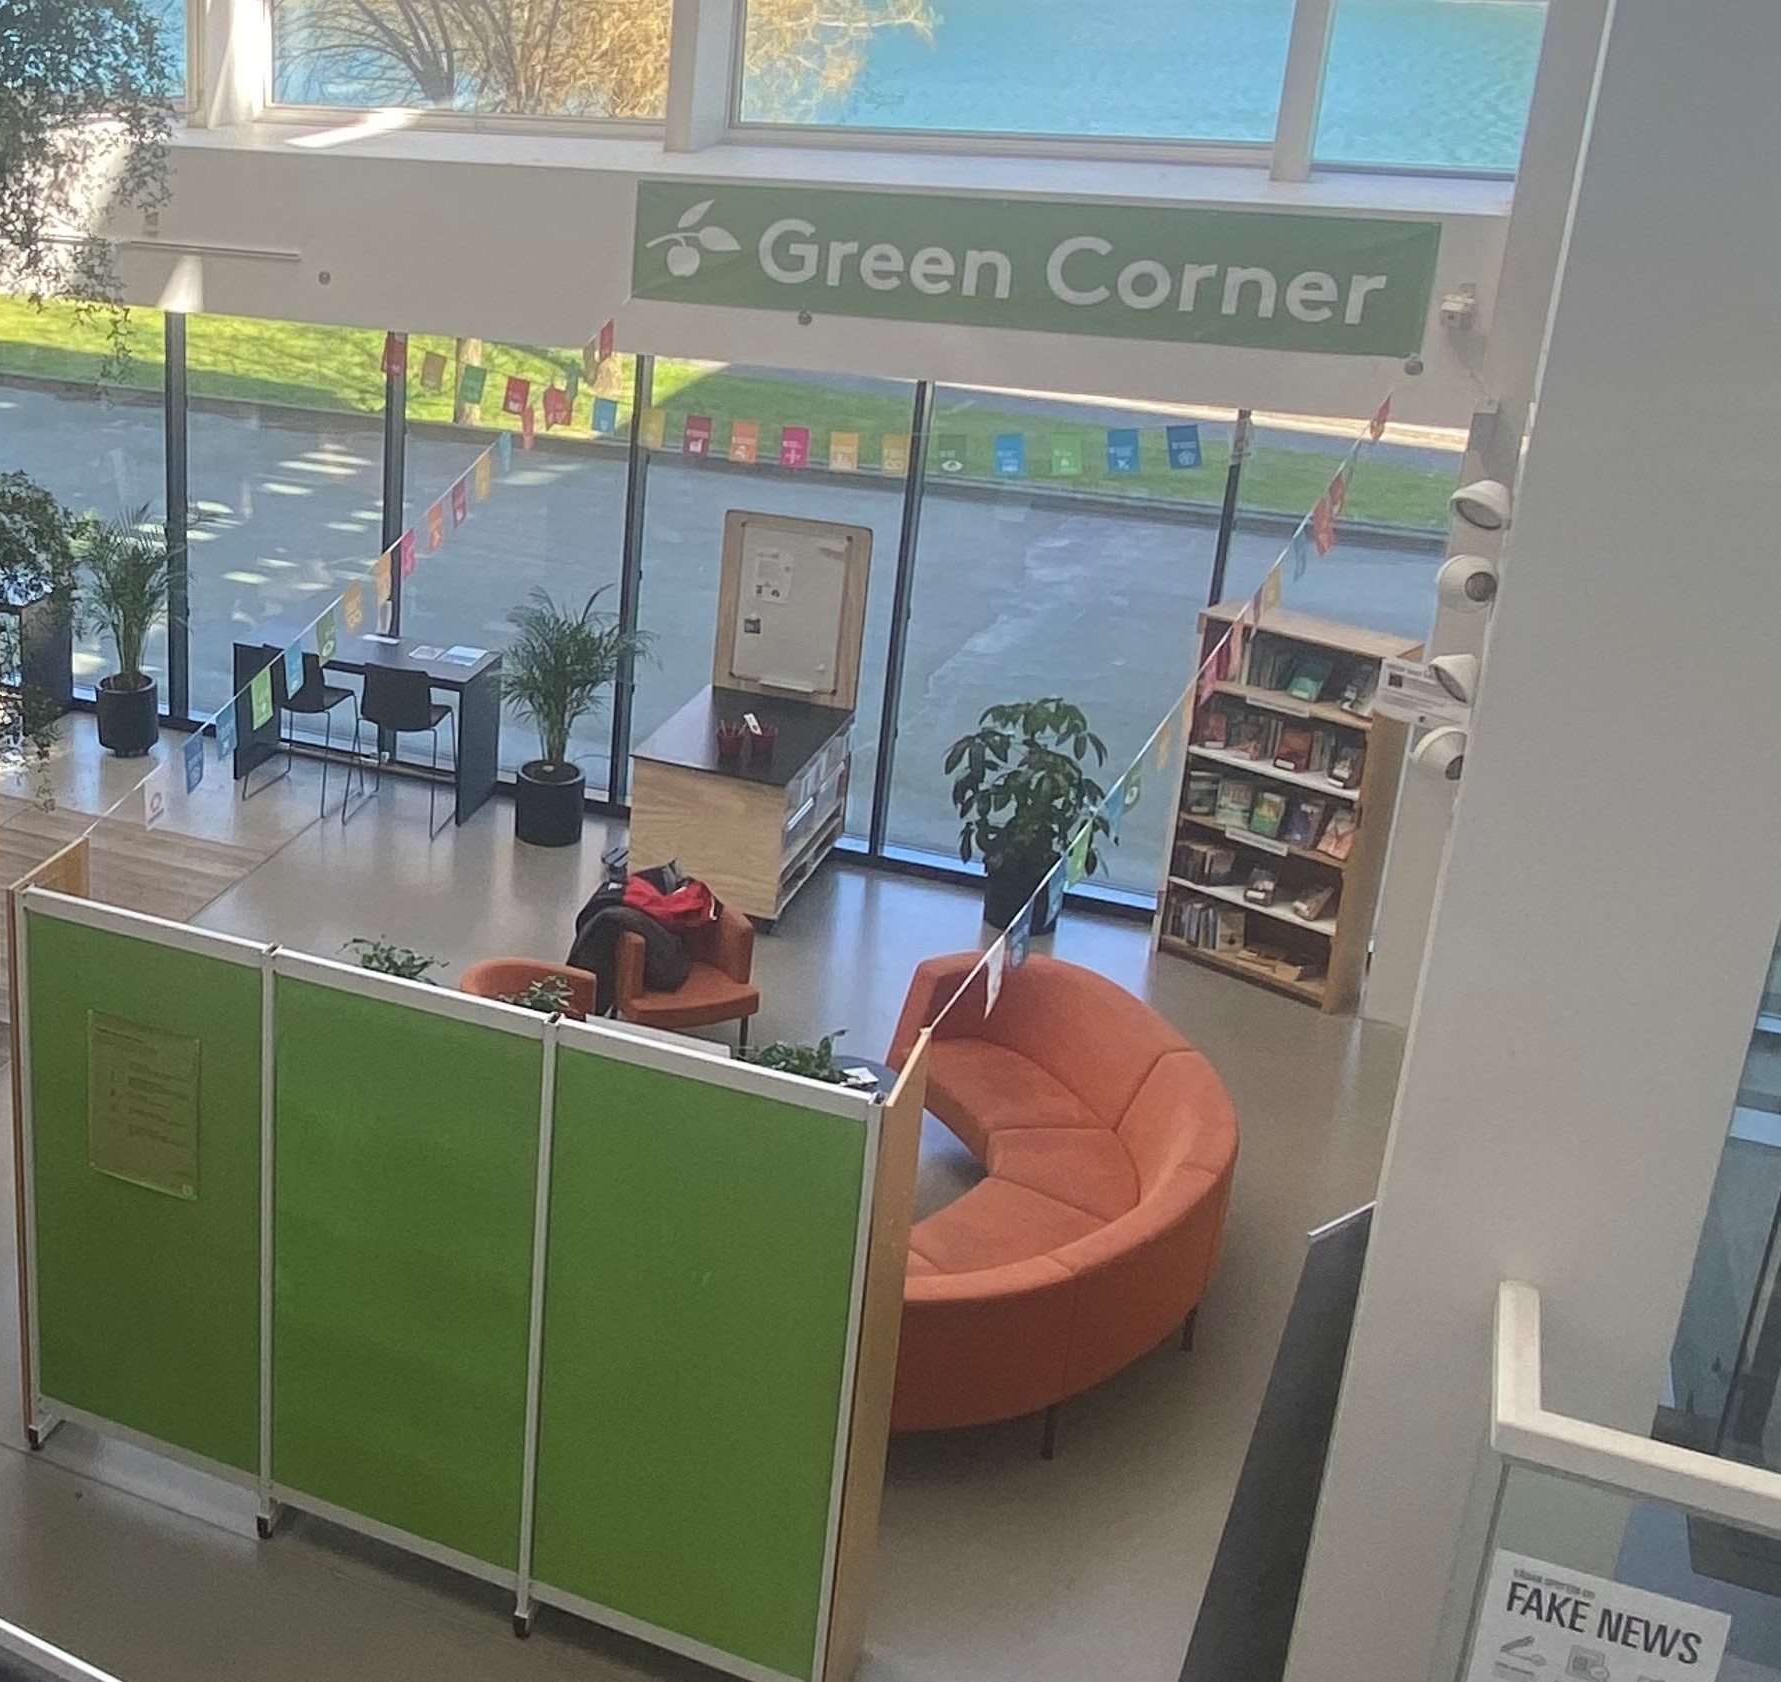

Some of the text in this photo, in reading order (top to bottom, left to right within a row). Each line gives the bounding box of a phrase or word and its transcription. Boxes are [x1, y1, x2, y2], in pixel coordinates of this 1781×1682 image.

[759, 218, 1387, 325] Green Corner
[1506, 1582, 1592, 1633] FAKE
[1597, 1608, 1702, 1664] NEWS
